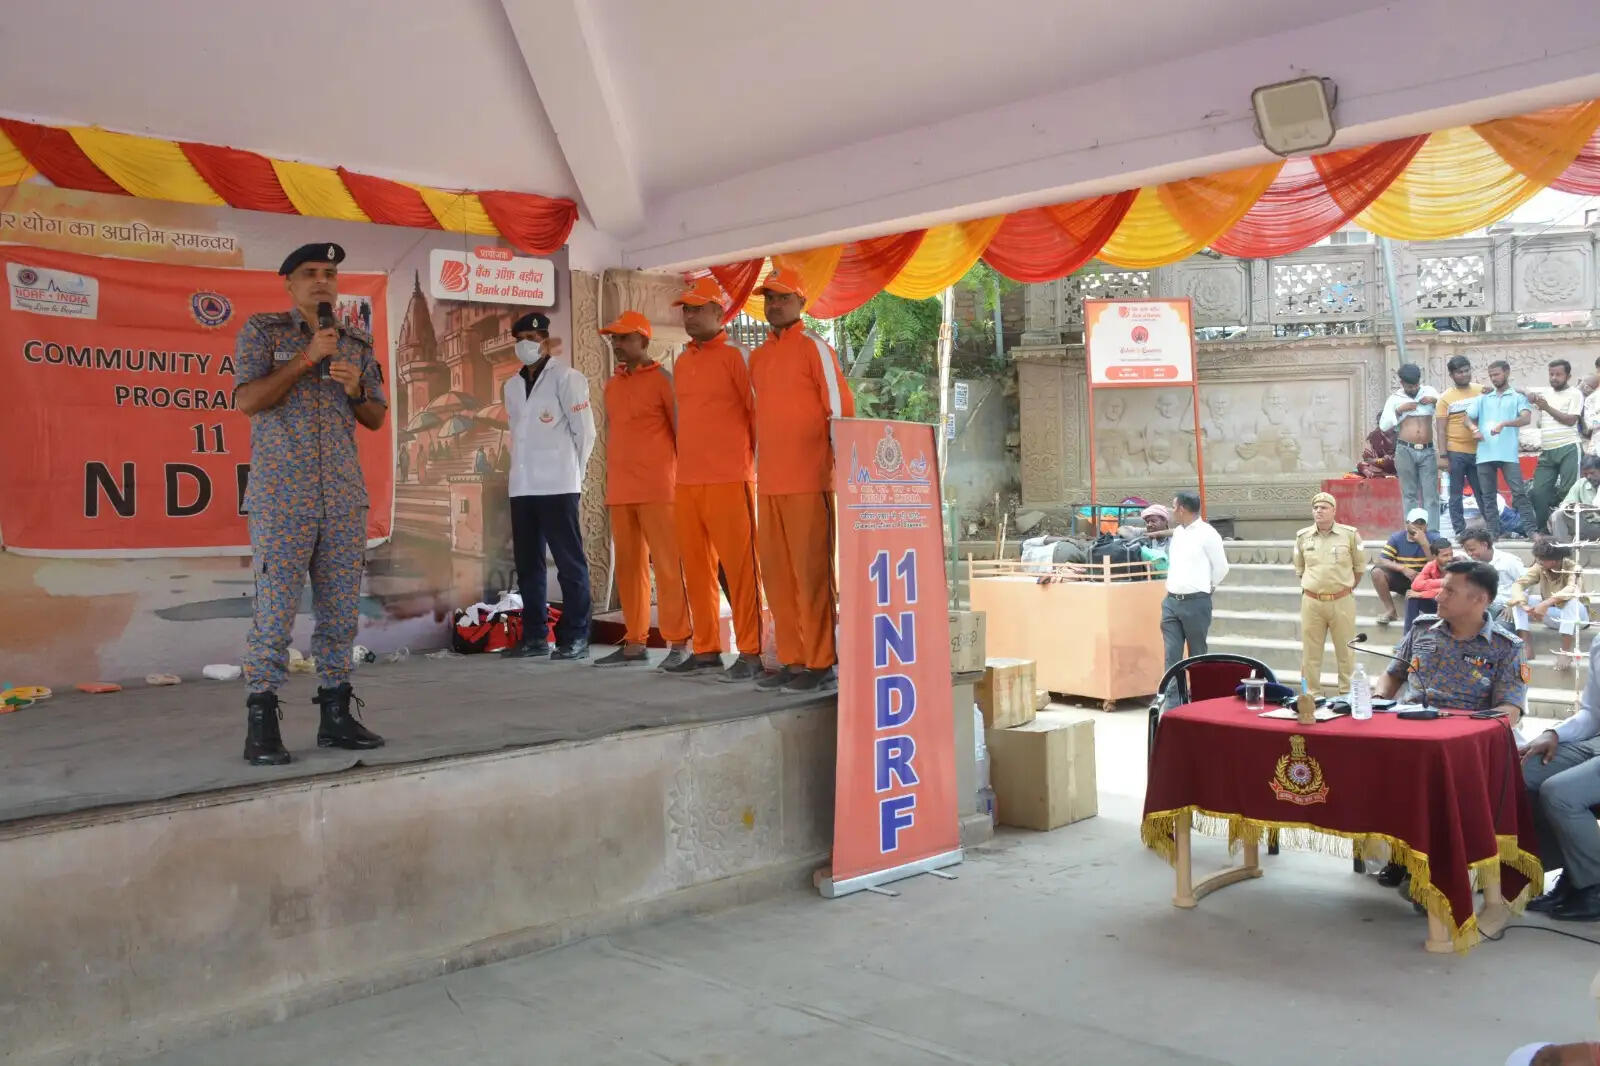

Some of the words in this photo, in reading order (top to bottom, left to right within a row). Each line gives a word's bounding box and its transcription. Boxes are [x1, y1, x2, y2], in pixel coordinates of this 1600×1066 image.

[23, 211, 62, 235] योग
[69, 221, 96, 237] का
[102, 222, 164, 244] अप्रतिम
[171, 231, 234, 251] समन्वय
[57, 294, 89, 305] INDIA
[475, 283, 499, 296] Bank
[501, 286, 511, 297] of
[511, 286, 544, 299] Baroda
[23, 340, 211, 376] COMMUNITY
[191, 423, 229, 454] 11
[868, 549, 918, 606] 11
[873, 611, 919, 855] NDRF
